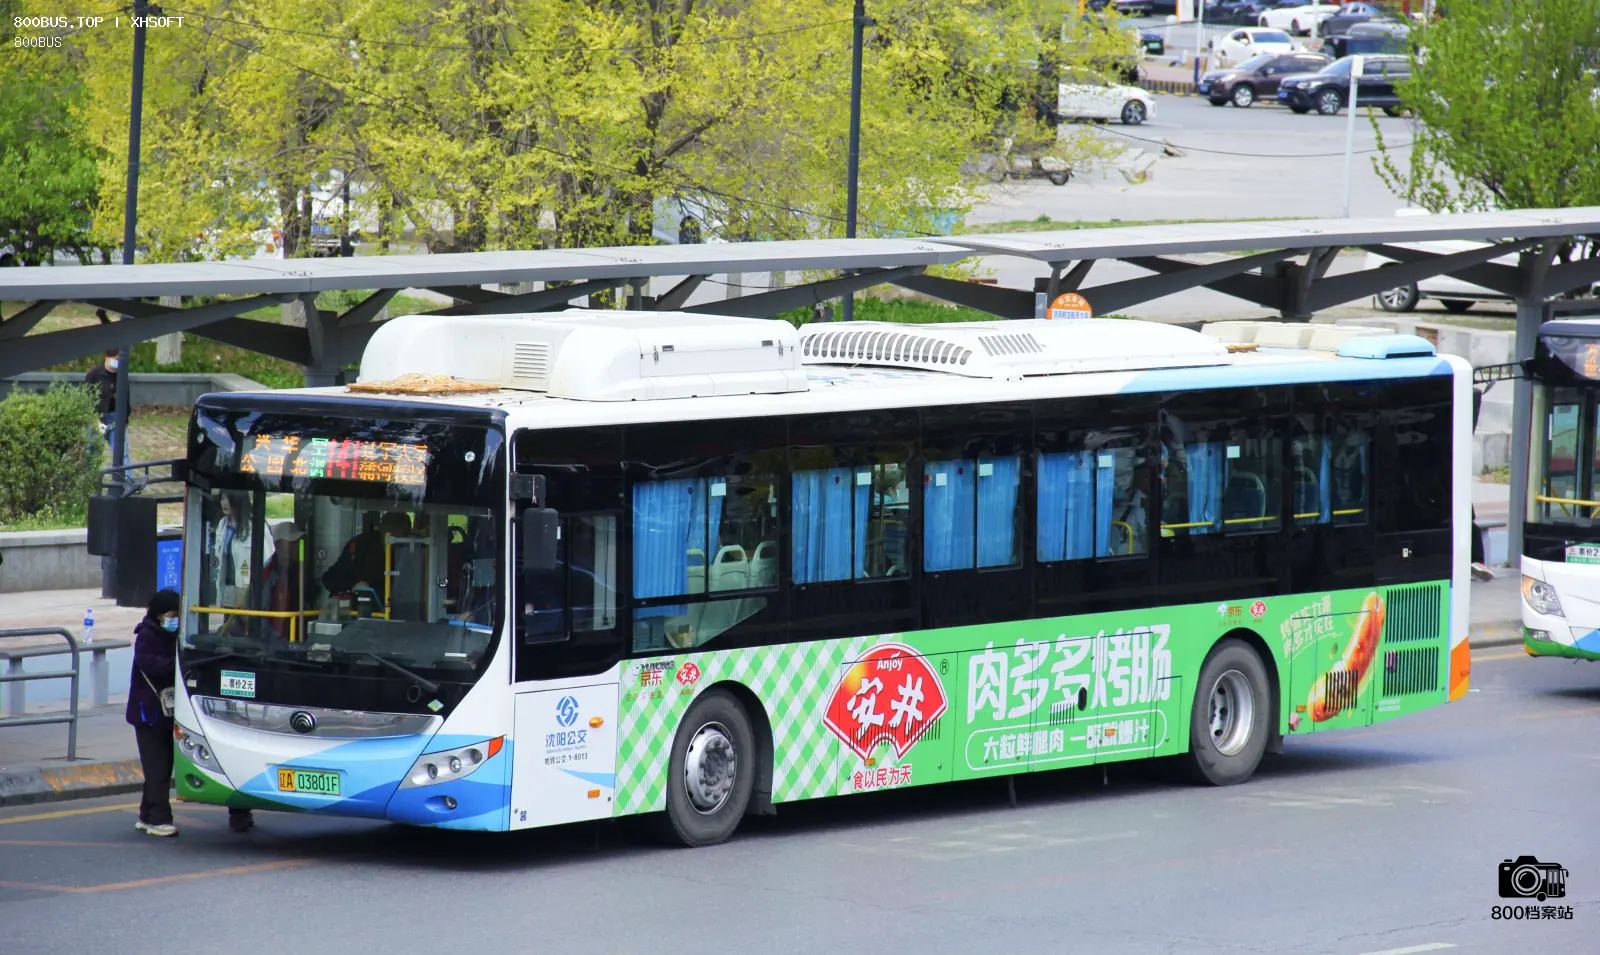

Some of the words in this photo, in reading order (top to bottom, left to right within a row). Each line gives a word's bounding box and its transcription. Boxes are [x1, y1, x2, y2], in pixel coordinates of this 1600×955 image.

[877, 653, 903, 670] Anjoy
[229, 678, 254, 691] 票价2元
[640, 670, 662, 687] 京东
[967, 624, 1172, 724] 肉多多烤肠
[847, 673, 925, 740] 安井
[545, 729, 587, 747] 沈阳公交
[983, 728, 1064, 761] 大粒鲜腿肉
[853, 764, 912, 790] 食以民为天
